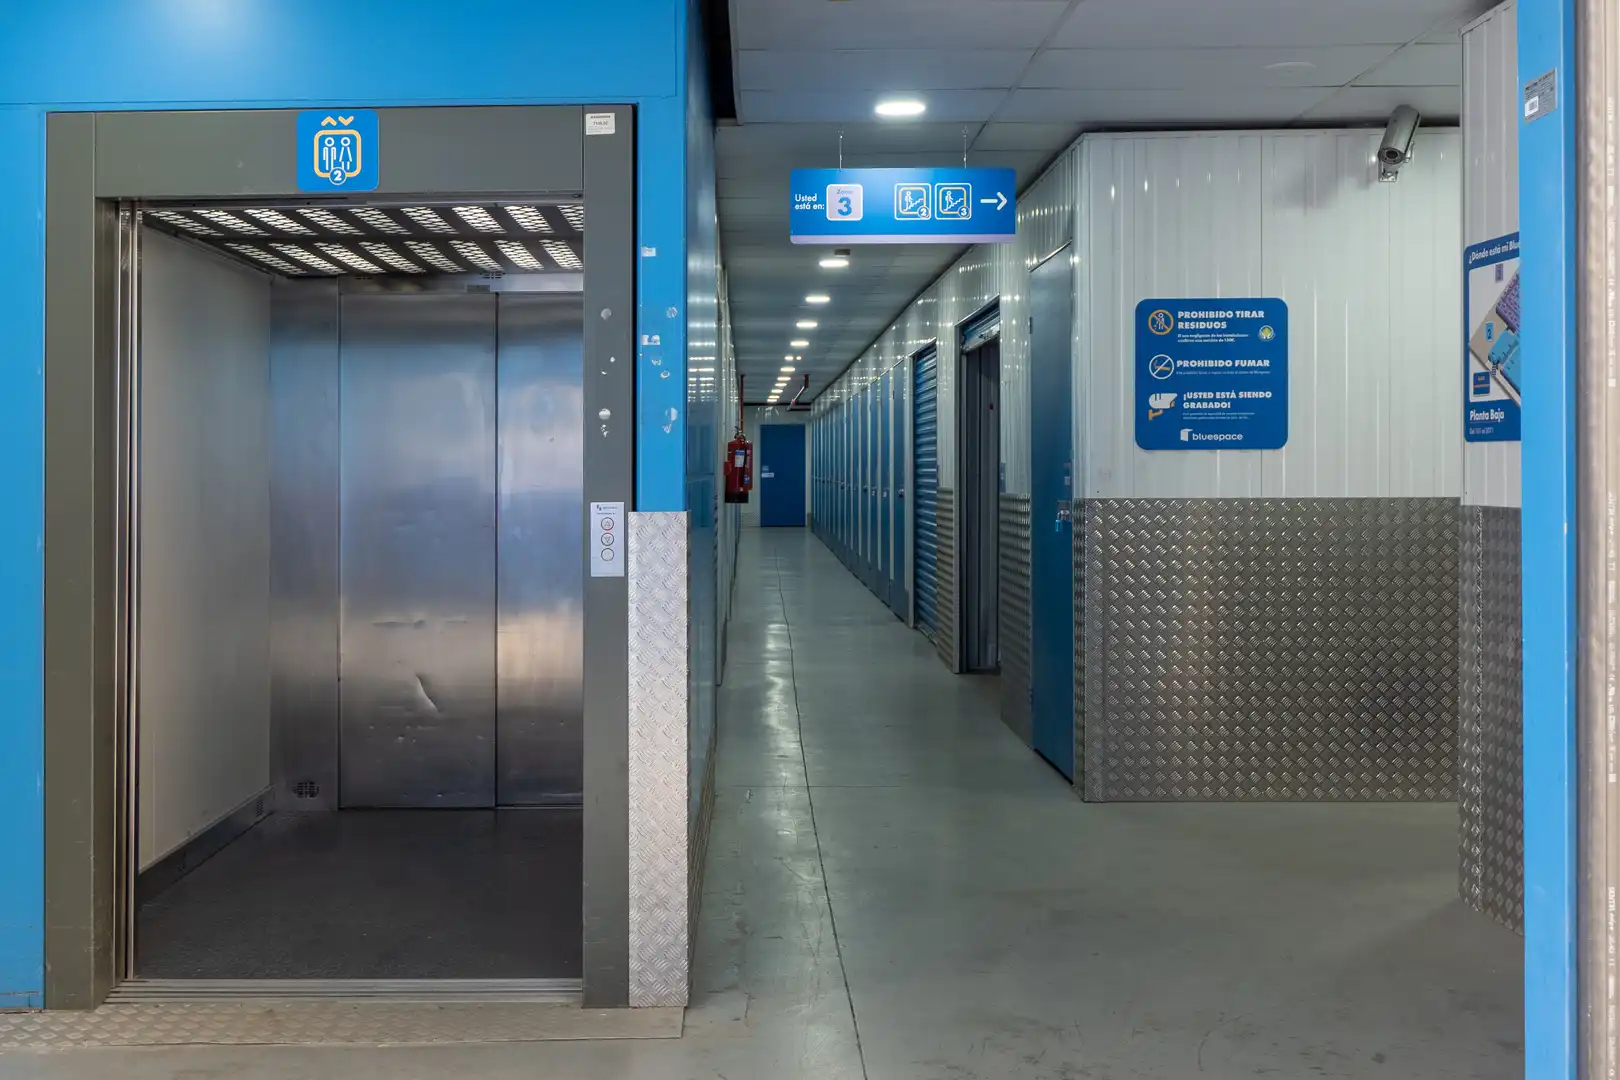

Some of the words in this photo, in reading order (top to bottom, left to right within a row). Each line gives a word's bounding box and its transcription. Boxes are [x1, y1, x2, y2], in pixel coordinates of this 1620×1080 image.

[333, 170, 342, 181] 2
[794, 193, 818, 202] Usted
[794, 202, 811, 210] está
[837, 196, 853, 217] 3
[920, 207, 927, 216] 2
[961, 207, 968, 216] 3
[1468, 247, 1489, 264] ¿Dónde
[1489, 243, 1501, 256] está
[1501, 241, 1510, 253] mi
[1177, 310, 1234, 319] PROHIBIDO
[1235, 310, 1265, 318] TIRAR
[1177, 321, 1228, 330] RESIDUOS
[1176, 360, 1233, 368] PROHIBIDO
[1234, 359, 1270, 367] FUMAR
[1183, 391, 1214, 401] ¡USTED
[1215, 389, 1237, 399] ESTÁ
[1238, 391, 1273, 399] SIENDO
[1183, 401, 1231, 409] GRABADO!
[1469, 408, 1490, 421] Planta
[1490, 407, 1505, 423] Baja
[1192, 433, 1244, 442] bluespace
